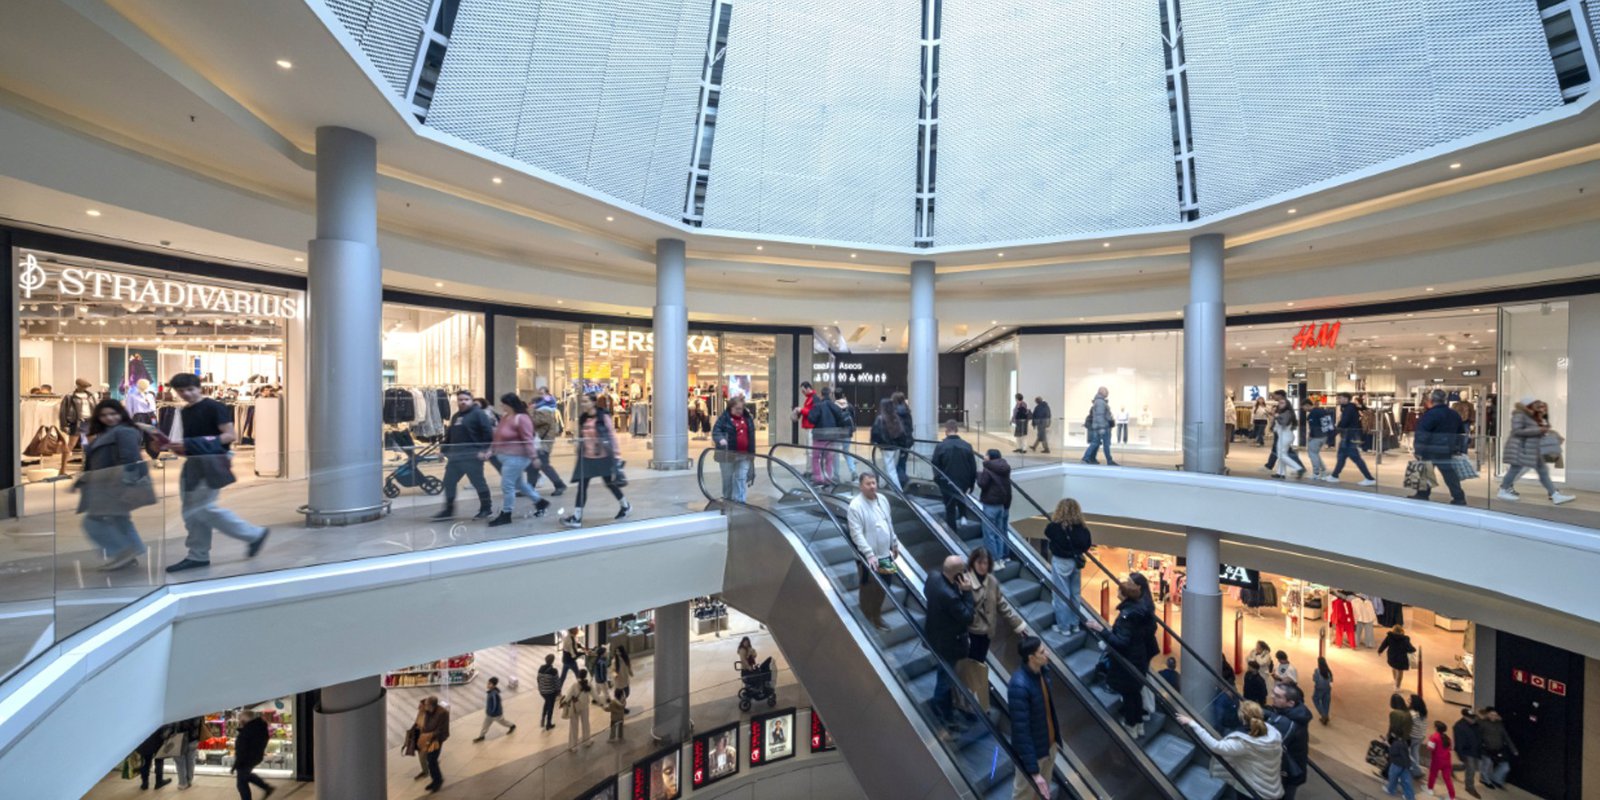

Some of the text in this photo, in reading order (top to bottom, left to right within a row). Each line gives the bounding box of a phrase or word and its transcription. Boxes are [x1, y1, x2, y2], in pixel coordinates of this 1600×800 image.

[58, 267, 298, 319] STRADIVARIUS
[590, 329, 716, 354] BERSKA
[1292, 321, 1341, 350] H&M
[838, 361, 863, 370] Aseos
